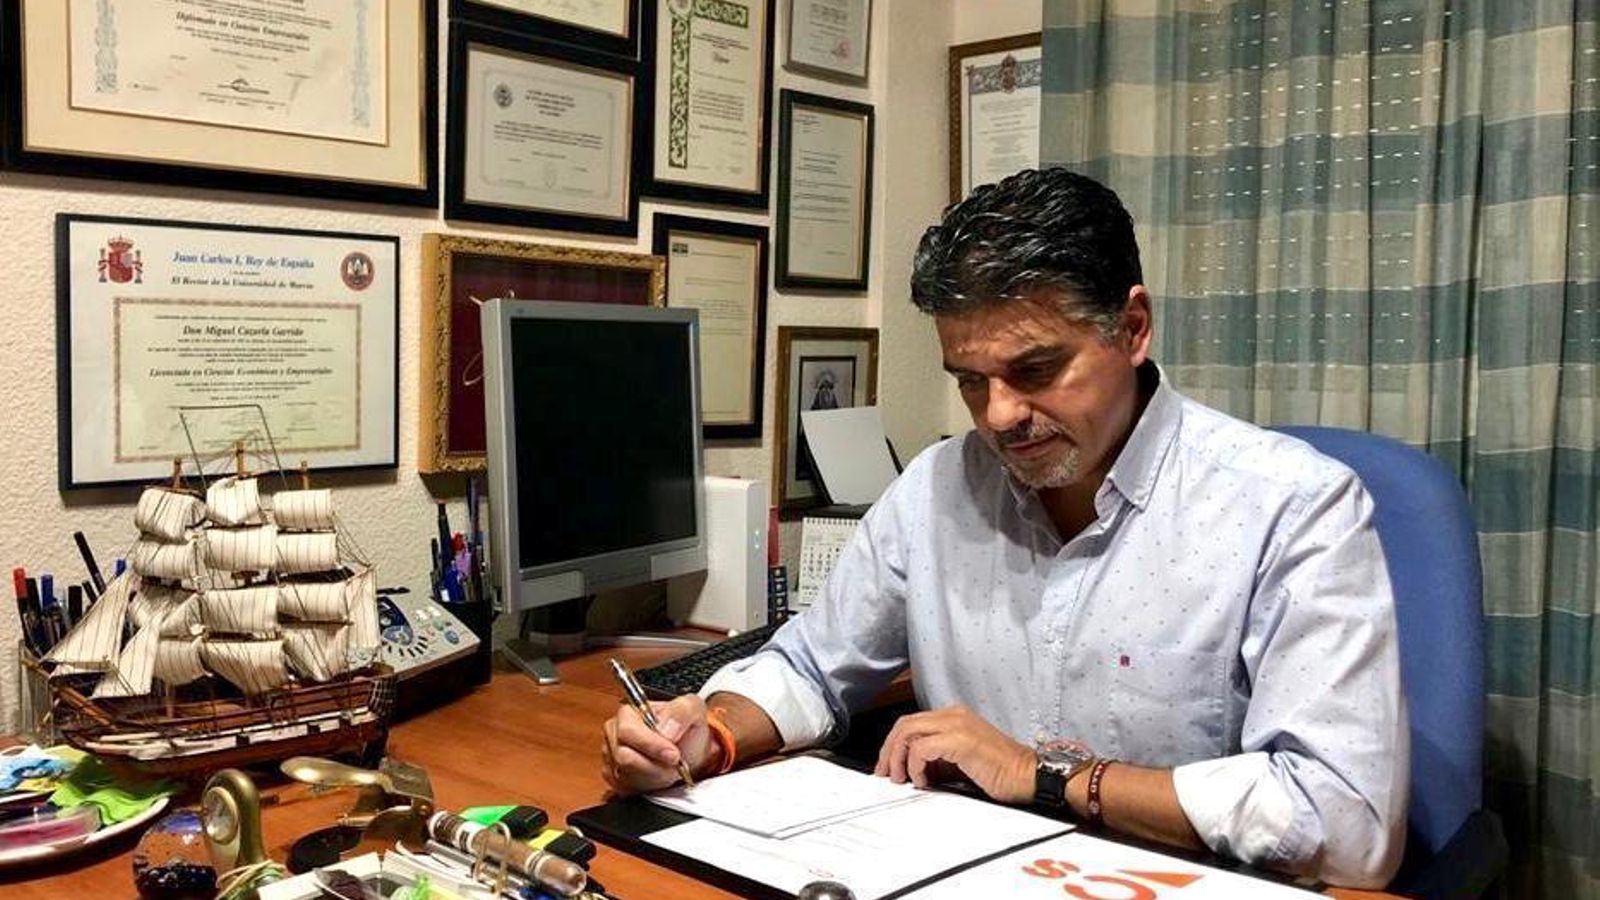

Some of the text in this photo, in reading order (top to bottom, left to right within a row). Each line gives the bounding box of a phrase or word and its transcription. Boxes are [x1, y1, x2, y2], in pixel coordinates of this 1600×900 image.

[172, 251, 198, 263] Juan
[200, 253, 233, 264] Carlos
[245, 256, 263, 267] Rey
[265, 257, 277, 266] de
[182, 277, 209, 285] Rector
[183, 325, 203, 336] Don
[205, 325, 236, 337] Miguel
[271, 326, 304, 337] Garrido
